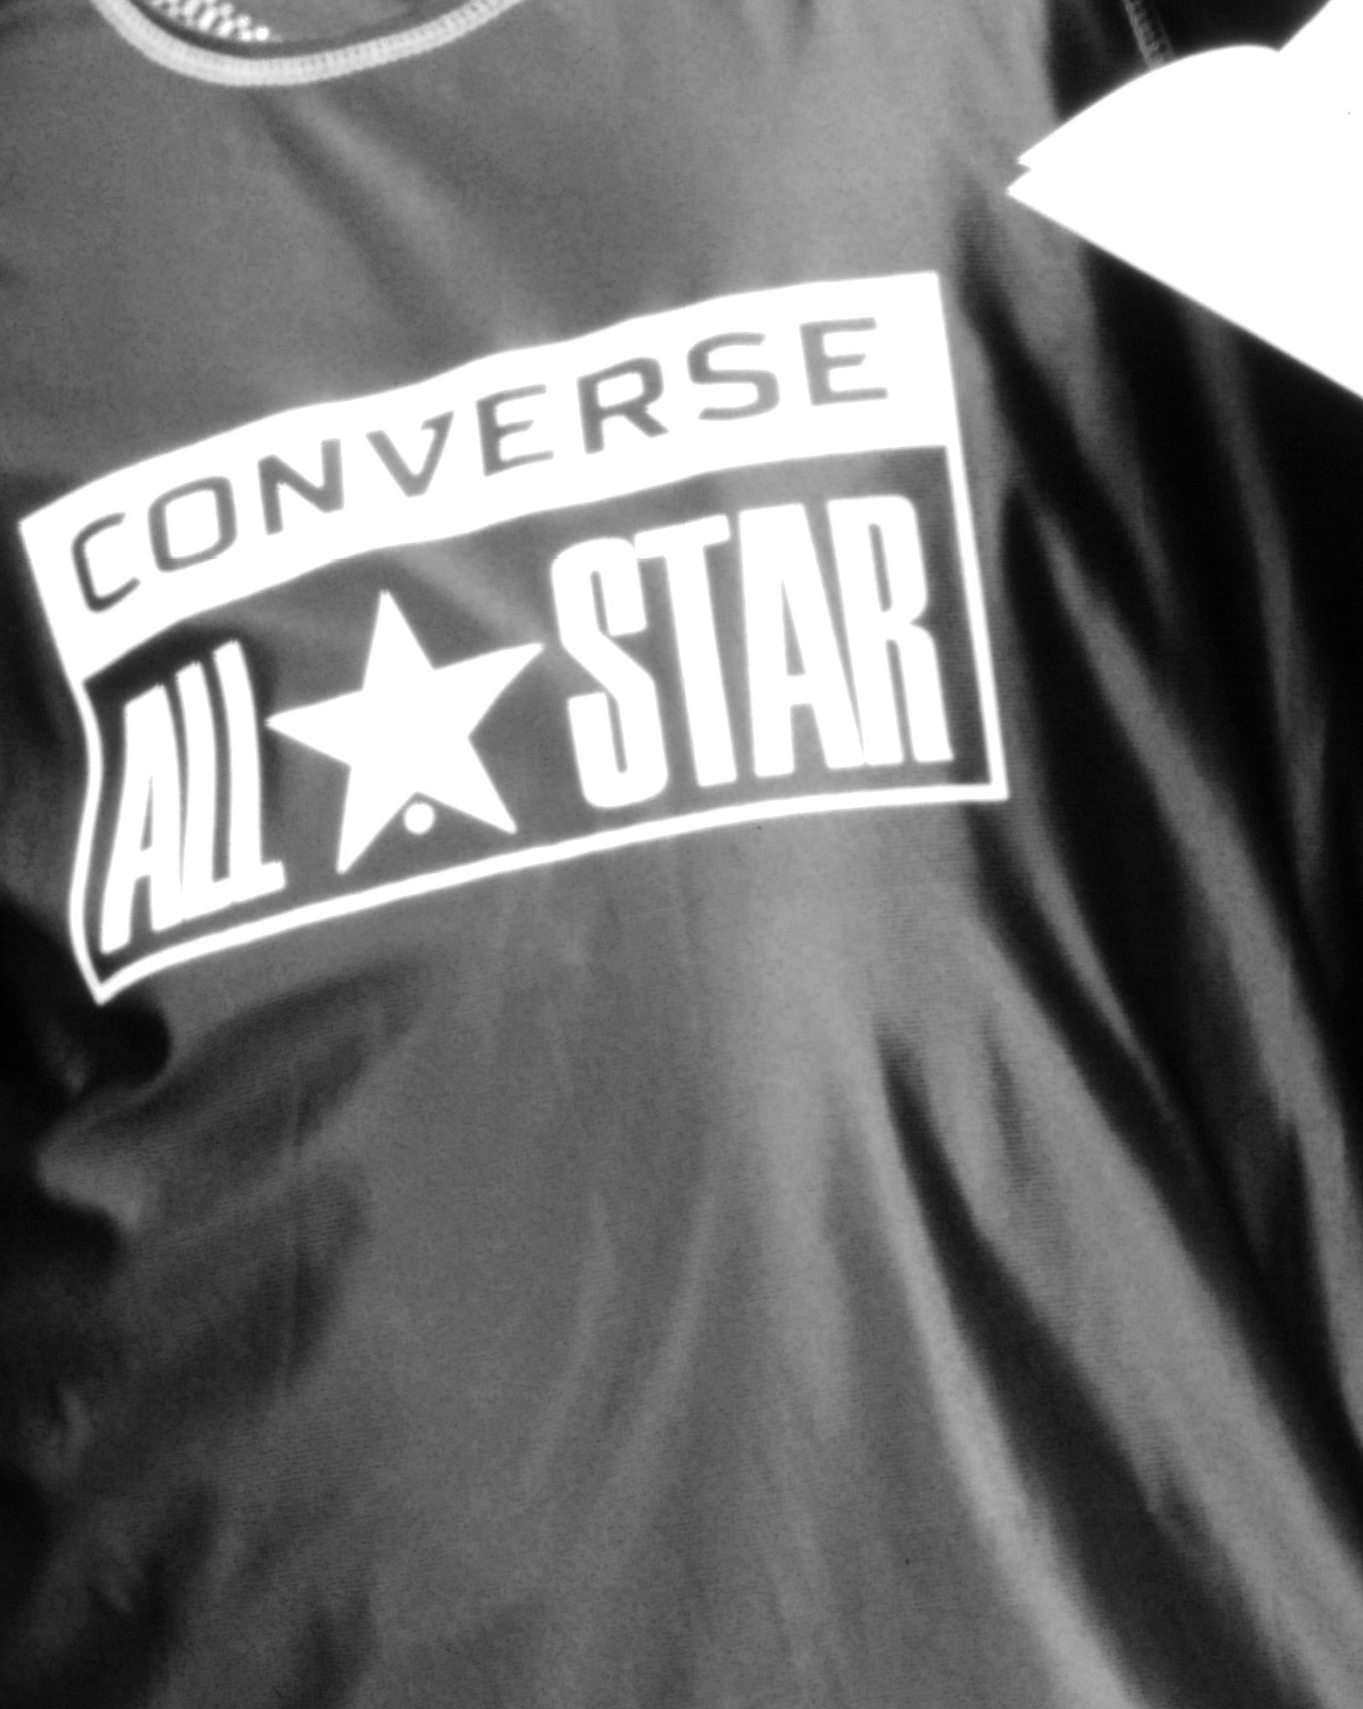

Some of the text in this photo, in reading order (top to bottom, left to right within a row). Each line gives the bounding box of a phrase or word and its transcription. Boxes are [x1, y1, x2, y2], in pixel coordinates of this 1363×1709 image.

[71, 317, 888, 612] CONVERSE
[100, 494, 953, 954] ALL STAR
